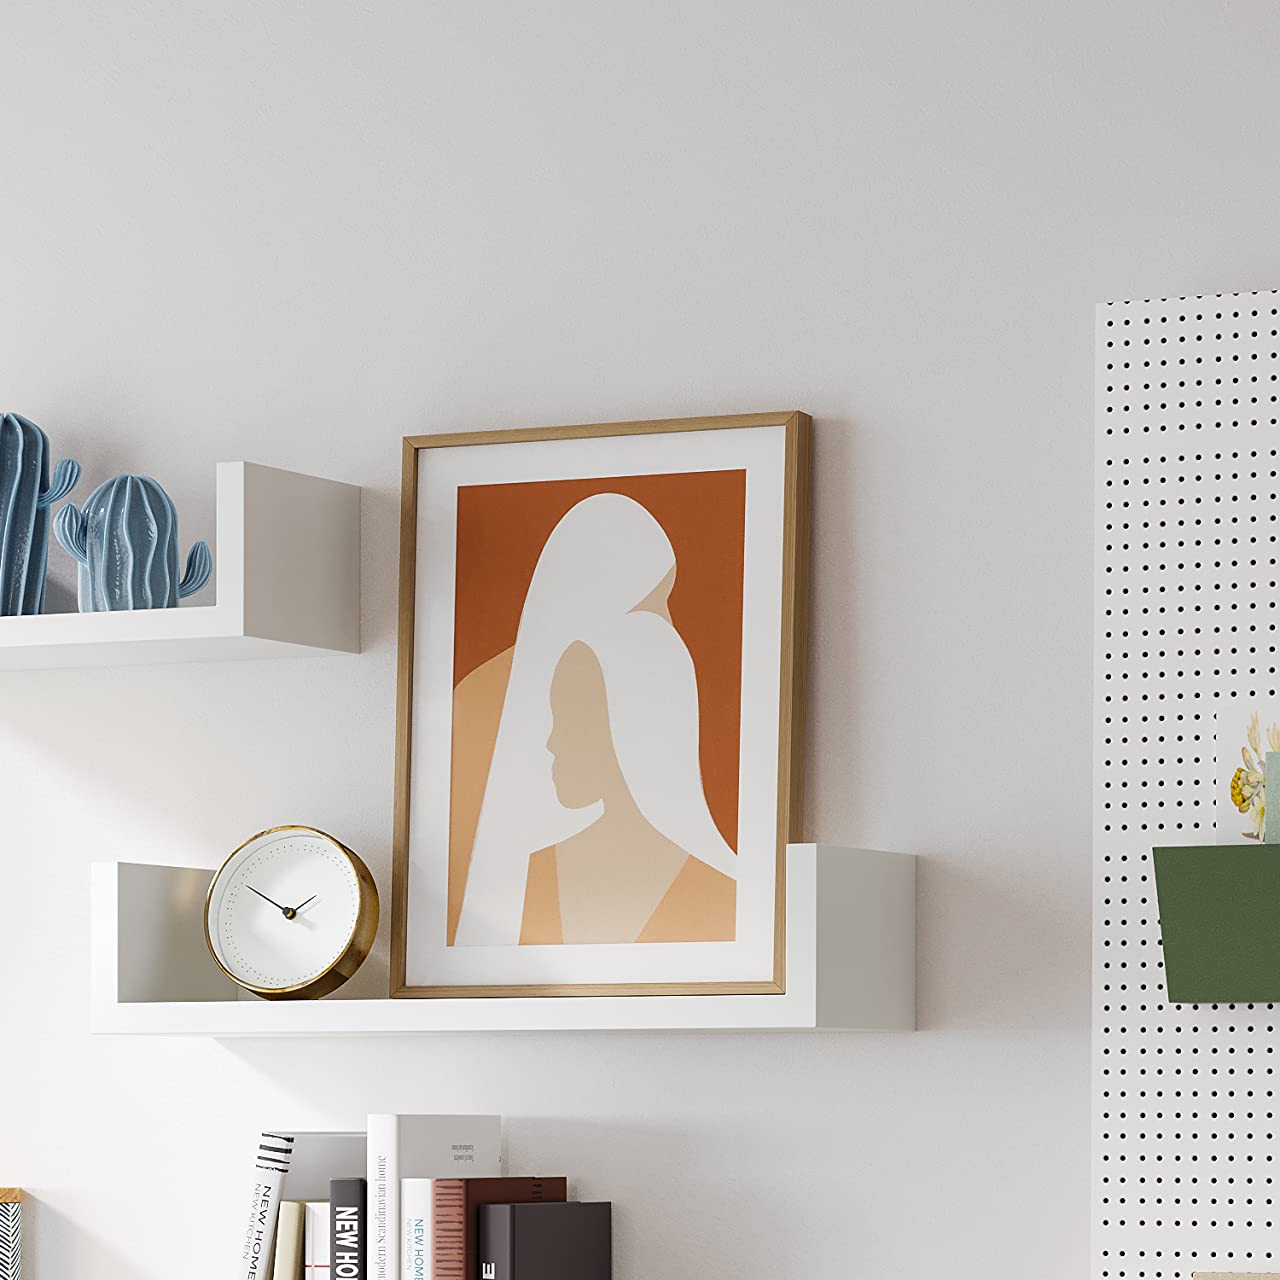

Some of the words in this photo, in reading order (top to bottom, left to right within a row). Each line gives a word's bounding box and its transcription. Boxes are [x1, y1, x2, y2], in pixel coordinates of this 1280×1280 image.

[374, 1155, 387, 1182] home
[251, 1183, 261, 1211] NEW
[257, 1185, 272, 1226] NEW
[374, 1183, 387, 1244] Scandinavian
[242, 1212, 257, 1260] KITCHEN
[335, 1206, 359, 1248] NEW
[414, 1218, 424, 1246] NEW
[247, 1230, 264, 1280] HOME
